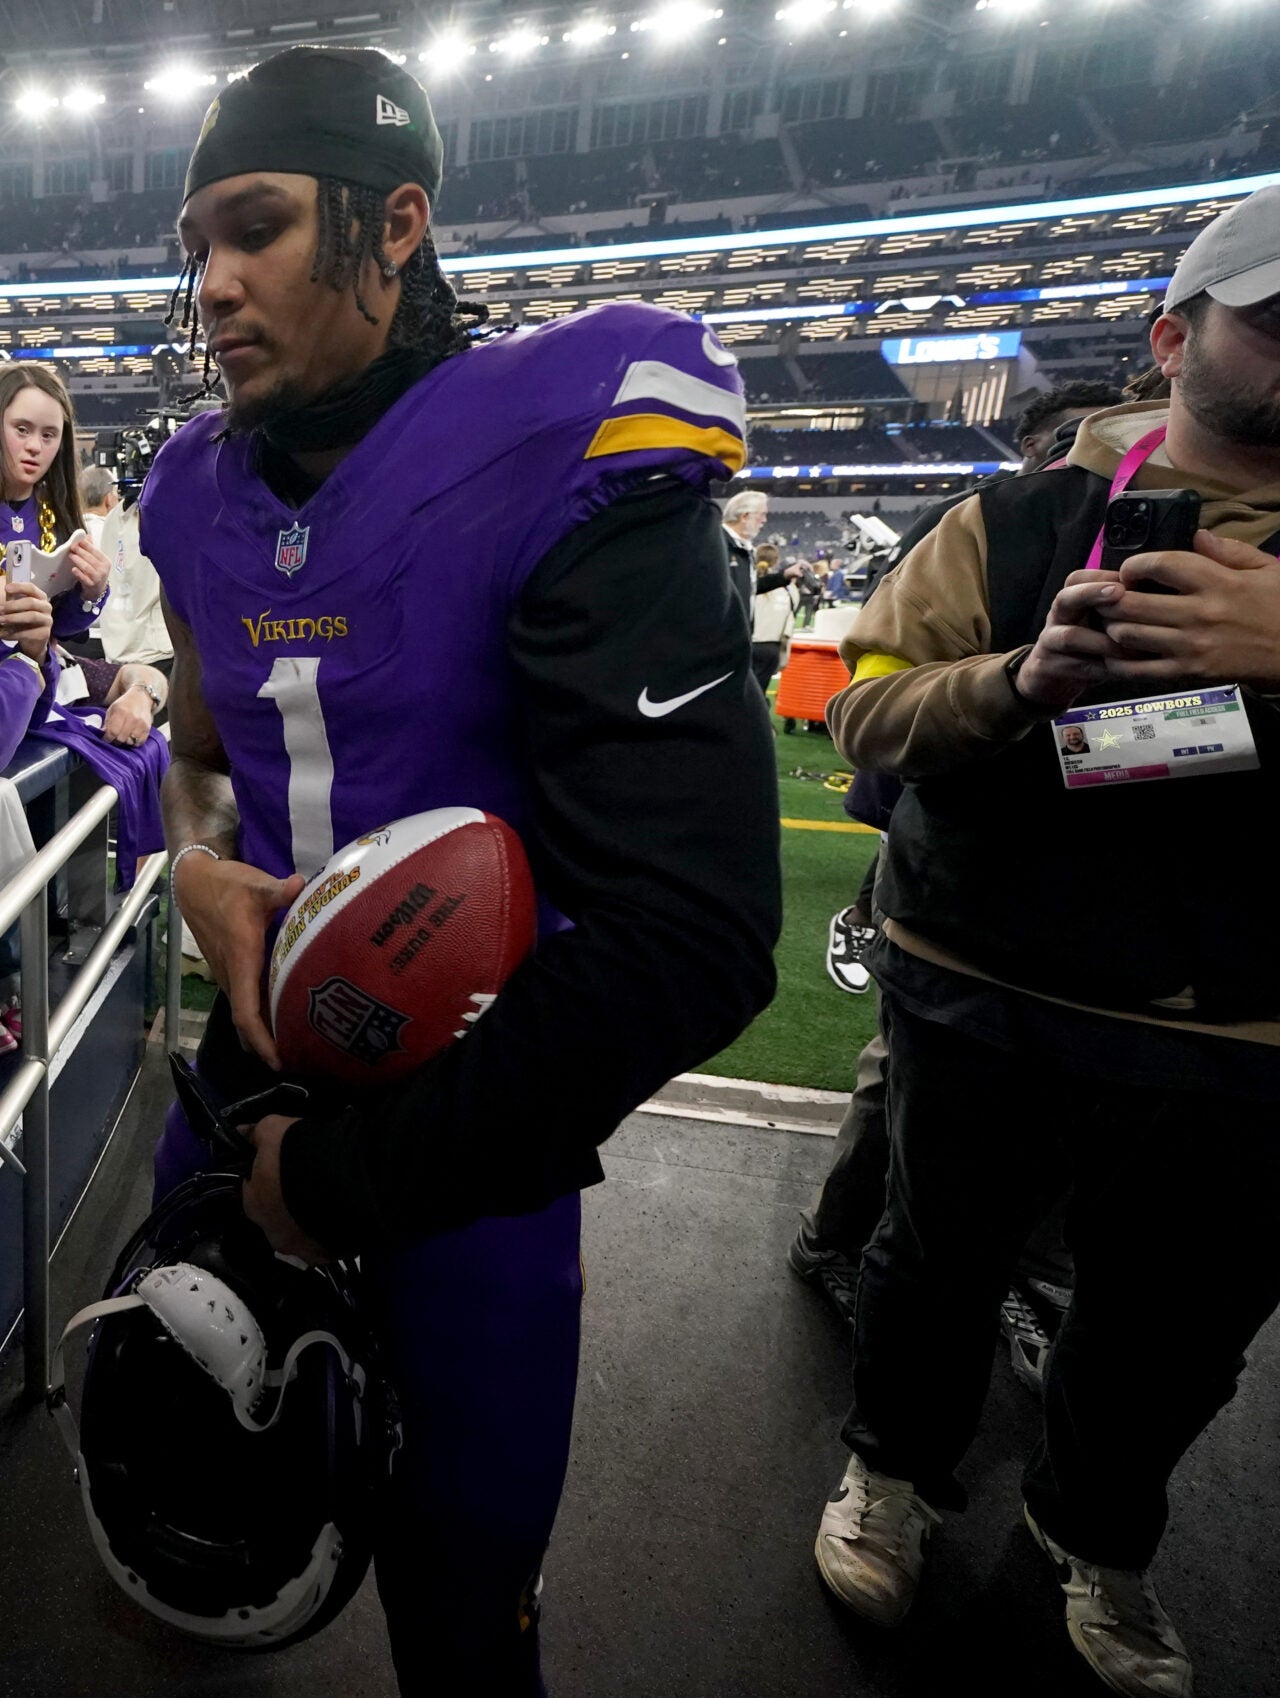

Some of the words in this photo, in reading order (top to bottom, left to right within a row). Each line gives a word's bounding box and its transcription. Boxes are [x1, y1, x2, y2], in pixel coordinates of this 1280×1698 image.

[279, 546, 302, 567] NFL
[1099, 707, 1133, 720] 2025
[1135, 696, 1202, 714] COWBOYS
[256, 657, 334, 878] 1
[308, 866, 360, 923] SUNDAY
